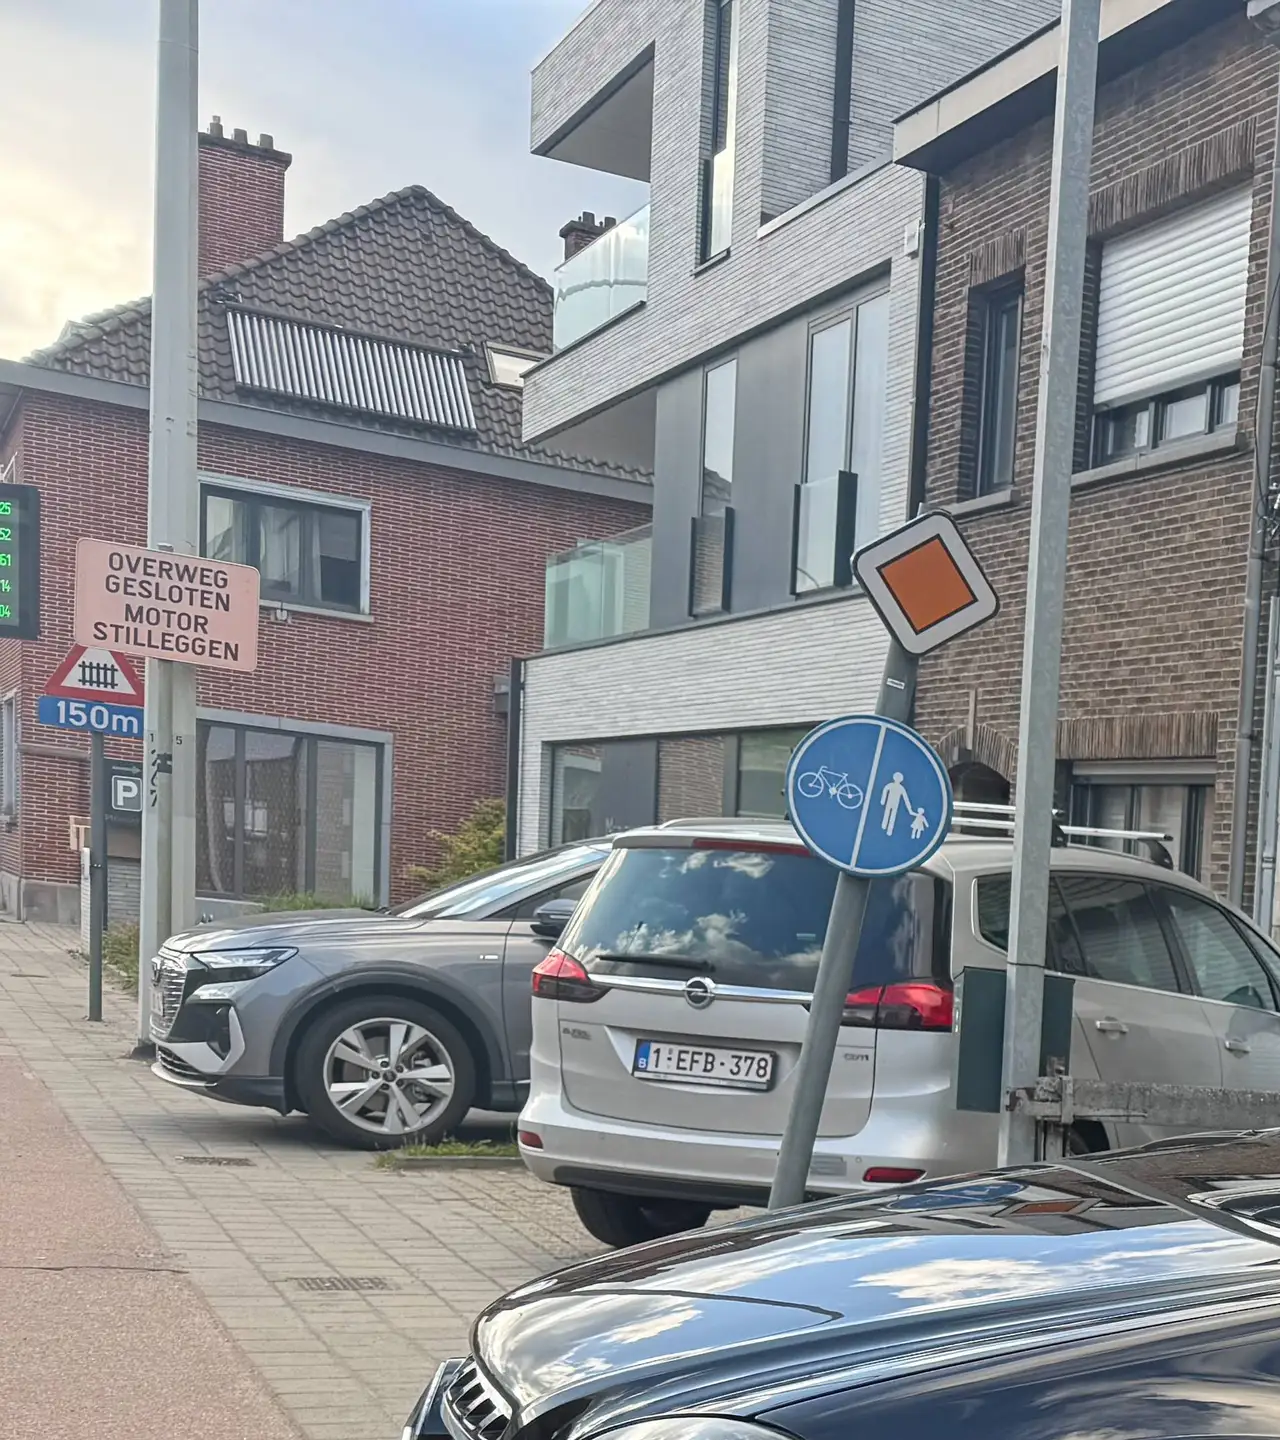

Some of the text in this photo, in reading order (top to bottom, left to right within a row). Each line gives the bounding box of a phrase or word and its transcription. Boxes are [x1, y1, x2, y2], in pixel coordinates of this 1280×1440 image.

[108, 552, 228, 589] OVERWEG
[105, 575, 230, 612] GESLOTEN
[124, 603, 209, 634] MOTOR
[93, 622, 239, 661] STILLEGGEN
[57, 700, 138, 734] 150m
[117, 780, 138, 806] P
[638, 1057, 647, 1069] B
